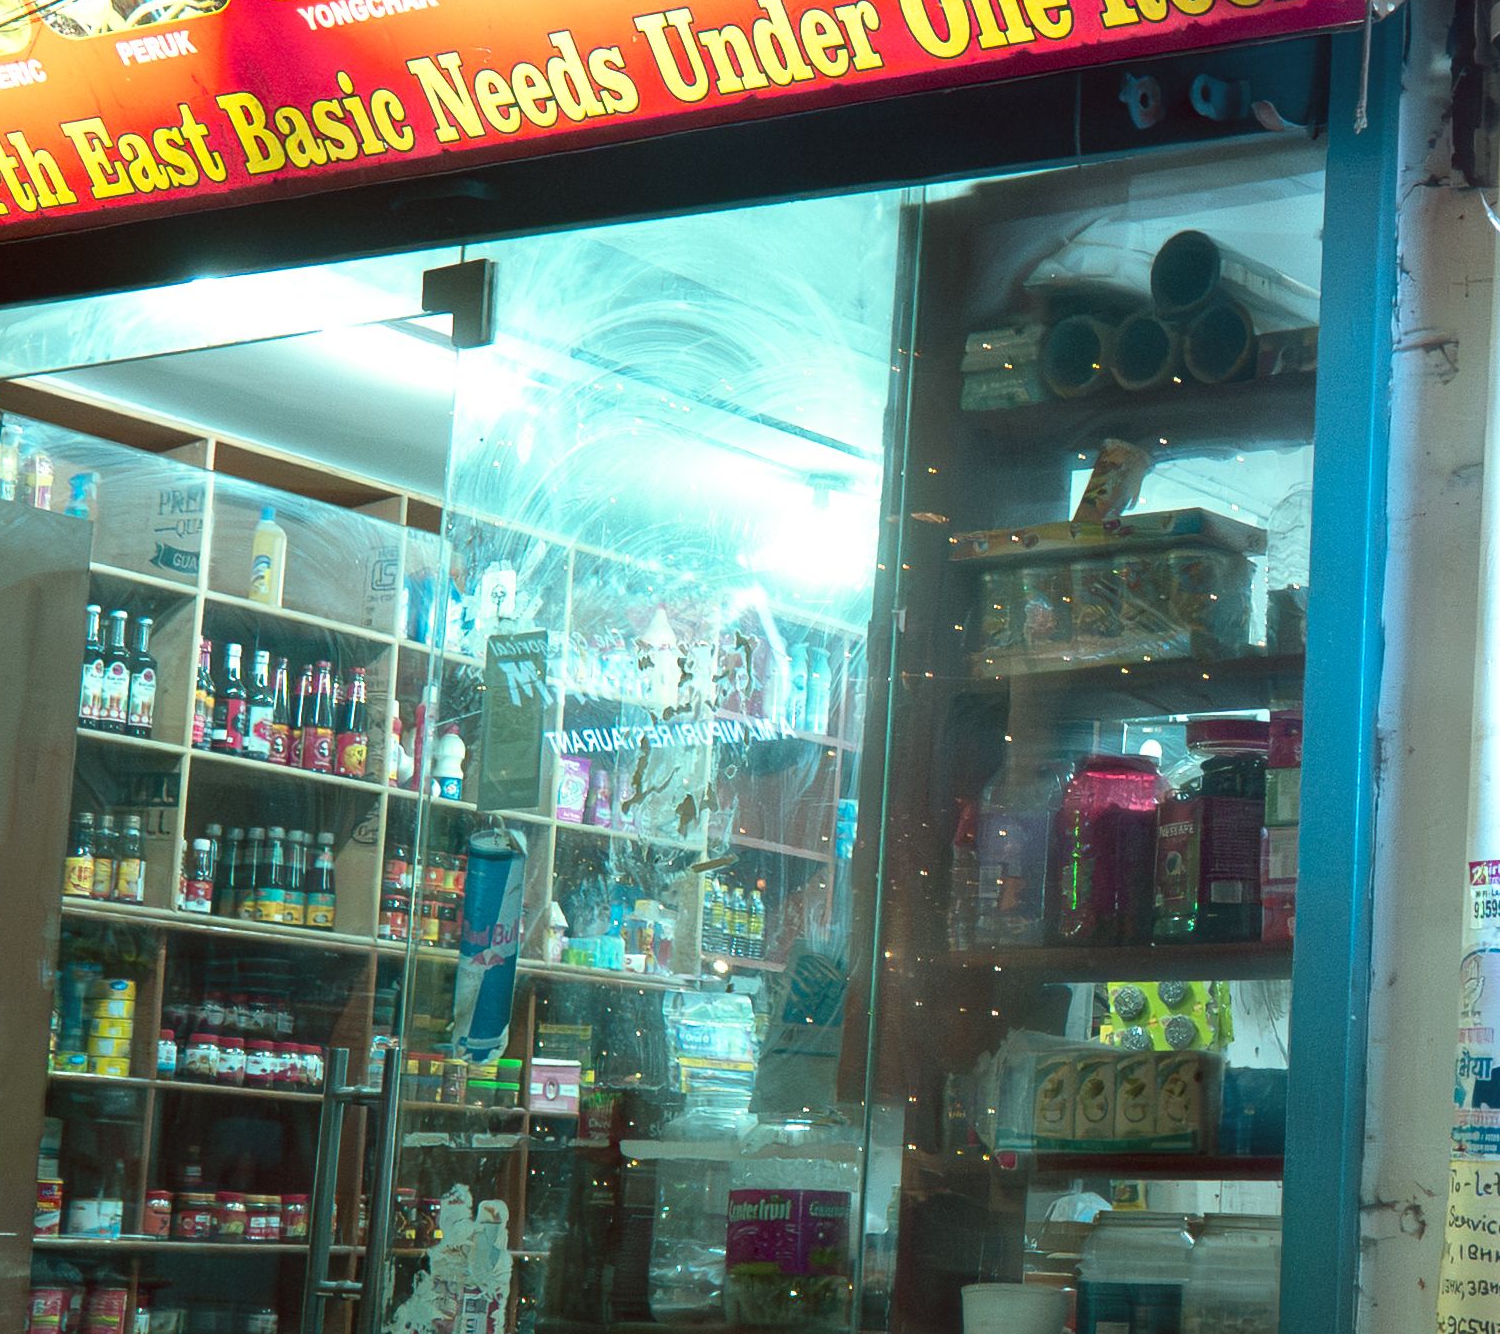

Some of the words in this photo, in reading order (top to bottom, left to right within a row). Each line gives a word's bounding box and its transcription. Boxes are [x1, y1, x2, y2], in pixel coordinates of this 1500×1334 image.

[115, 28, 198, 68] PERUK
[60, 103, 228, 201] East
[215, 69, 415, 177] Basic
[406, 28, 627, 146] Needs
